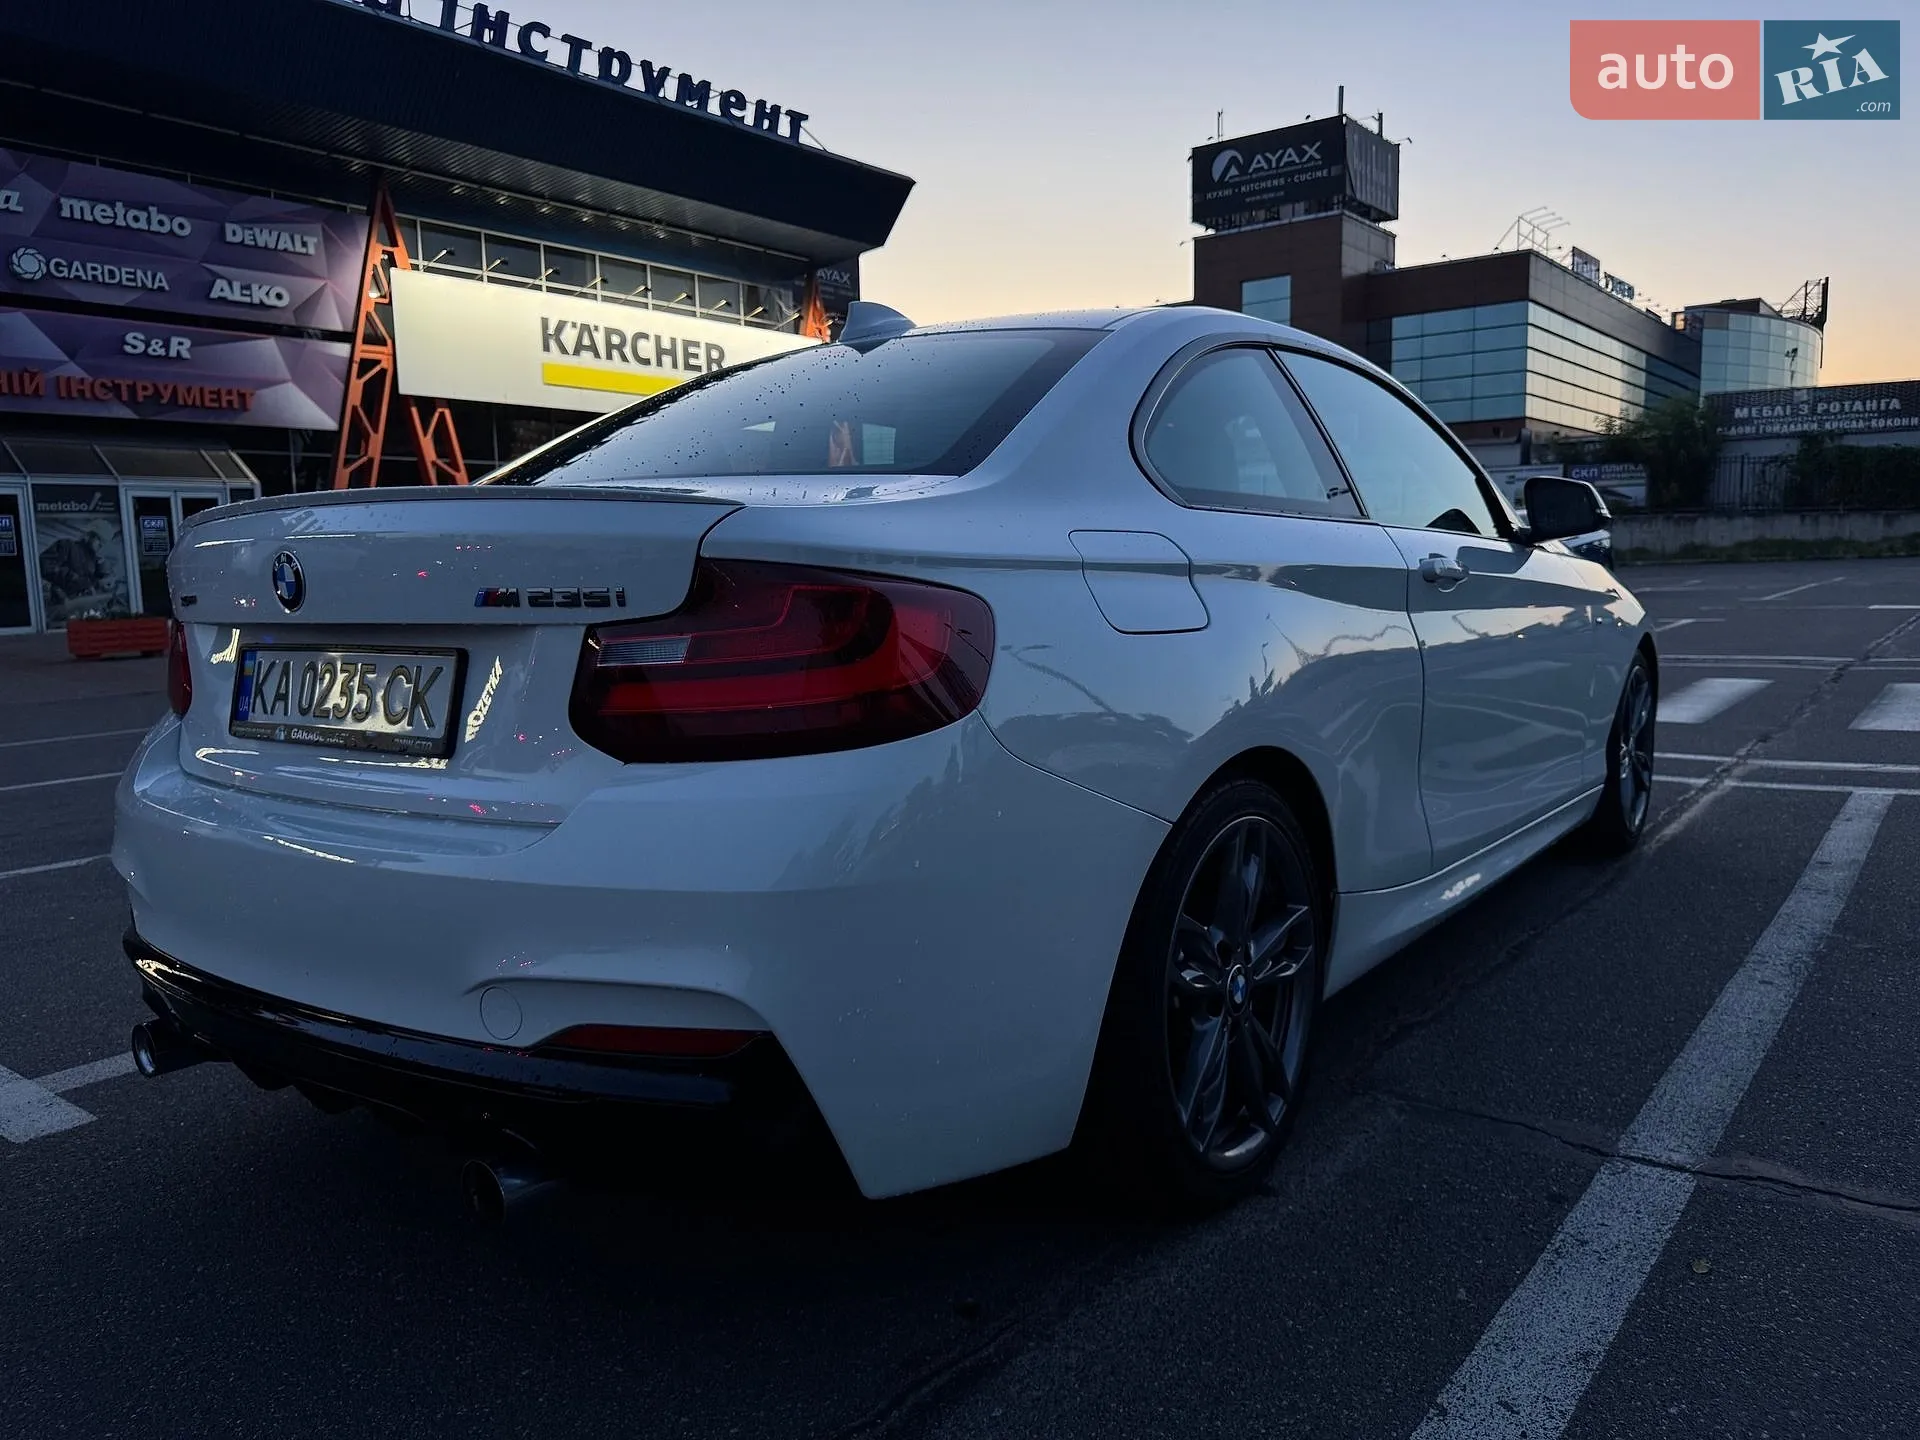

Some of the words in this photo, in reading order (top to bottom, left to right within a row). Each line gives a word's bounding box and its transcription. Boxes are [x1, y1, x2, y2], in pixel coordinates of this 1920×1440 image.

[1248, 140, 1323, 173] AYAX
[1240, 178, 1285, 194] KITCHENS
[1294, 168, 1329, 183] CUCINE
[59, 197, 192, 238] metabo
[48, 257, 170, 291] GARDENA
[123, 332, 192, 360] S&R
[540, 316, 727, 374] KÄRCHER
[57, 374, 256, 412] ІНСТРУМЕНТ
[1733, 404, 1792, 419] МЕБЛІ
[1816, 397, 1901, 414] РОТАНГА
[36, 500, 89, 512] metabo
[239, 695, 249, 712] UA
[252, 659, 293, 716] KA
[298, 661, 377, 723] 0235
[383, 664, 443, 729] CK
